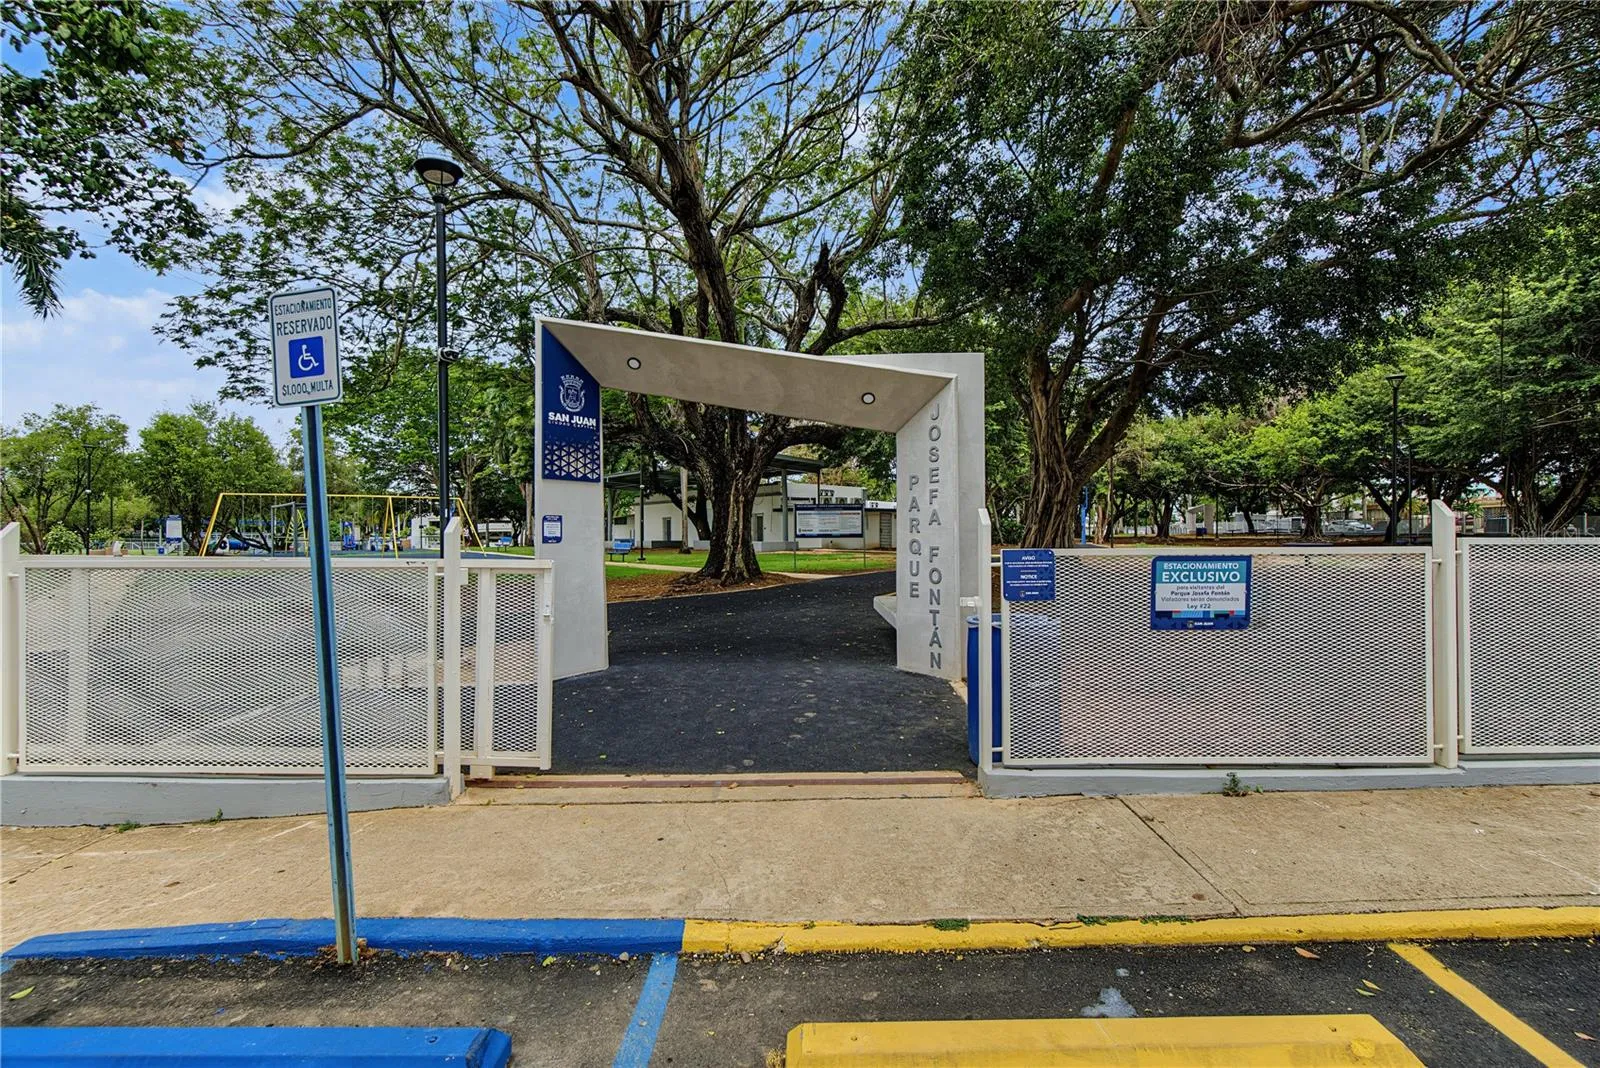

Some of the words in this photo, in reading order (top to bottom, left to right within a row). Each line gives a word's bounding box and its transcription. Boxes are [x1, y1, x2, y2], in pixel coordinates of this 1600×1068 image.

[274, 298, 332, 316] ESTACIONAMIENTO
[276, 315, 333, 337] RESERVADO
[310, 379, 333, 392] MULTA
[548, 411, 570, 423] SAN
[571, 415, 597, 427] JUAN
[928, 403, 942, 527] JOSEFA
[909, 475, 922, 599] PARQUE
[1163, 562, 1239, 570] ESTACIONAMIENTO
[1162, 571, 1241, 582] EXCLUSIVO
[928, 546, 943, 670] FONTÁN
